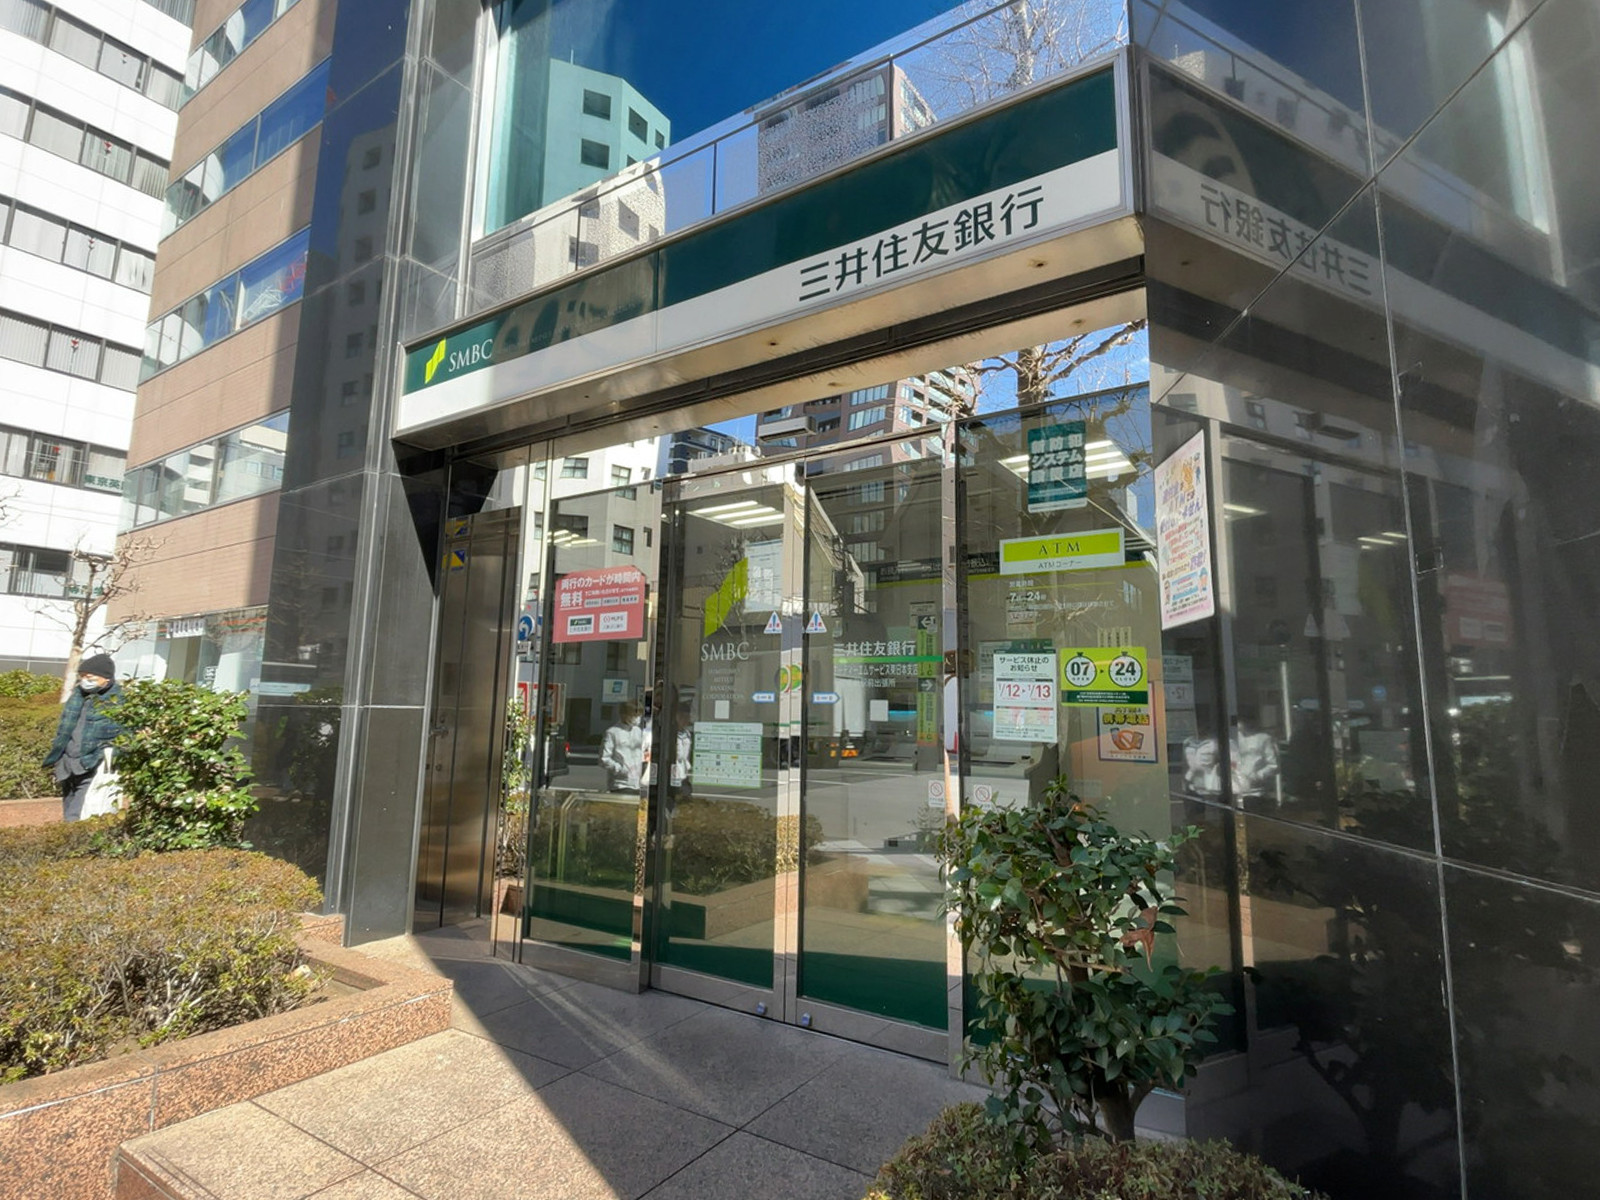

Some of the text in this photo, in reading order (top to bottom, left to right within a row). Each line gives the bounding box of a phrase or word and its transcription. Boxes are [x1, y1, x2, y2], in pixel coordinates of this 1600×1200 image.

[799, 185, 1044, 302] 三井住友銀行
[448, 338, 494, 373] SMBC
[1032, 449, 1083, 469] システム
[84, 474, 124, 490] 東京英
[1038, 541, 1080, 555] ATM
[1037, 560, 1082, 569] ATMコーナー
[560, 591, 582, 607] 無料
[700, 641, 750, 662] SMBC
[834, 641, 916, 657] 三井住友銀行
[999, 656, 1050, 665] サービス休止の
[1010, 664, 1038, 672] お知らせ
[1070, 661, 1136, 676] 07 24
